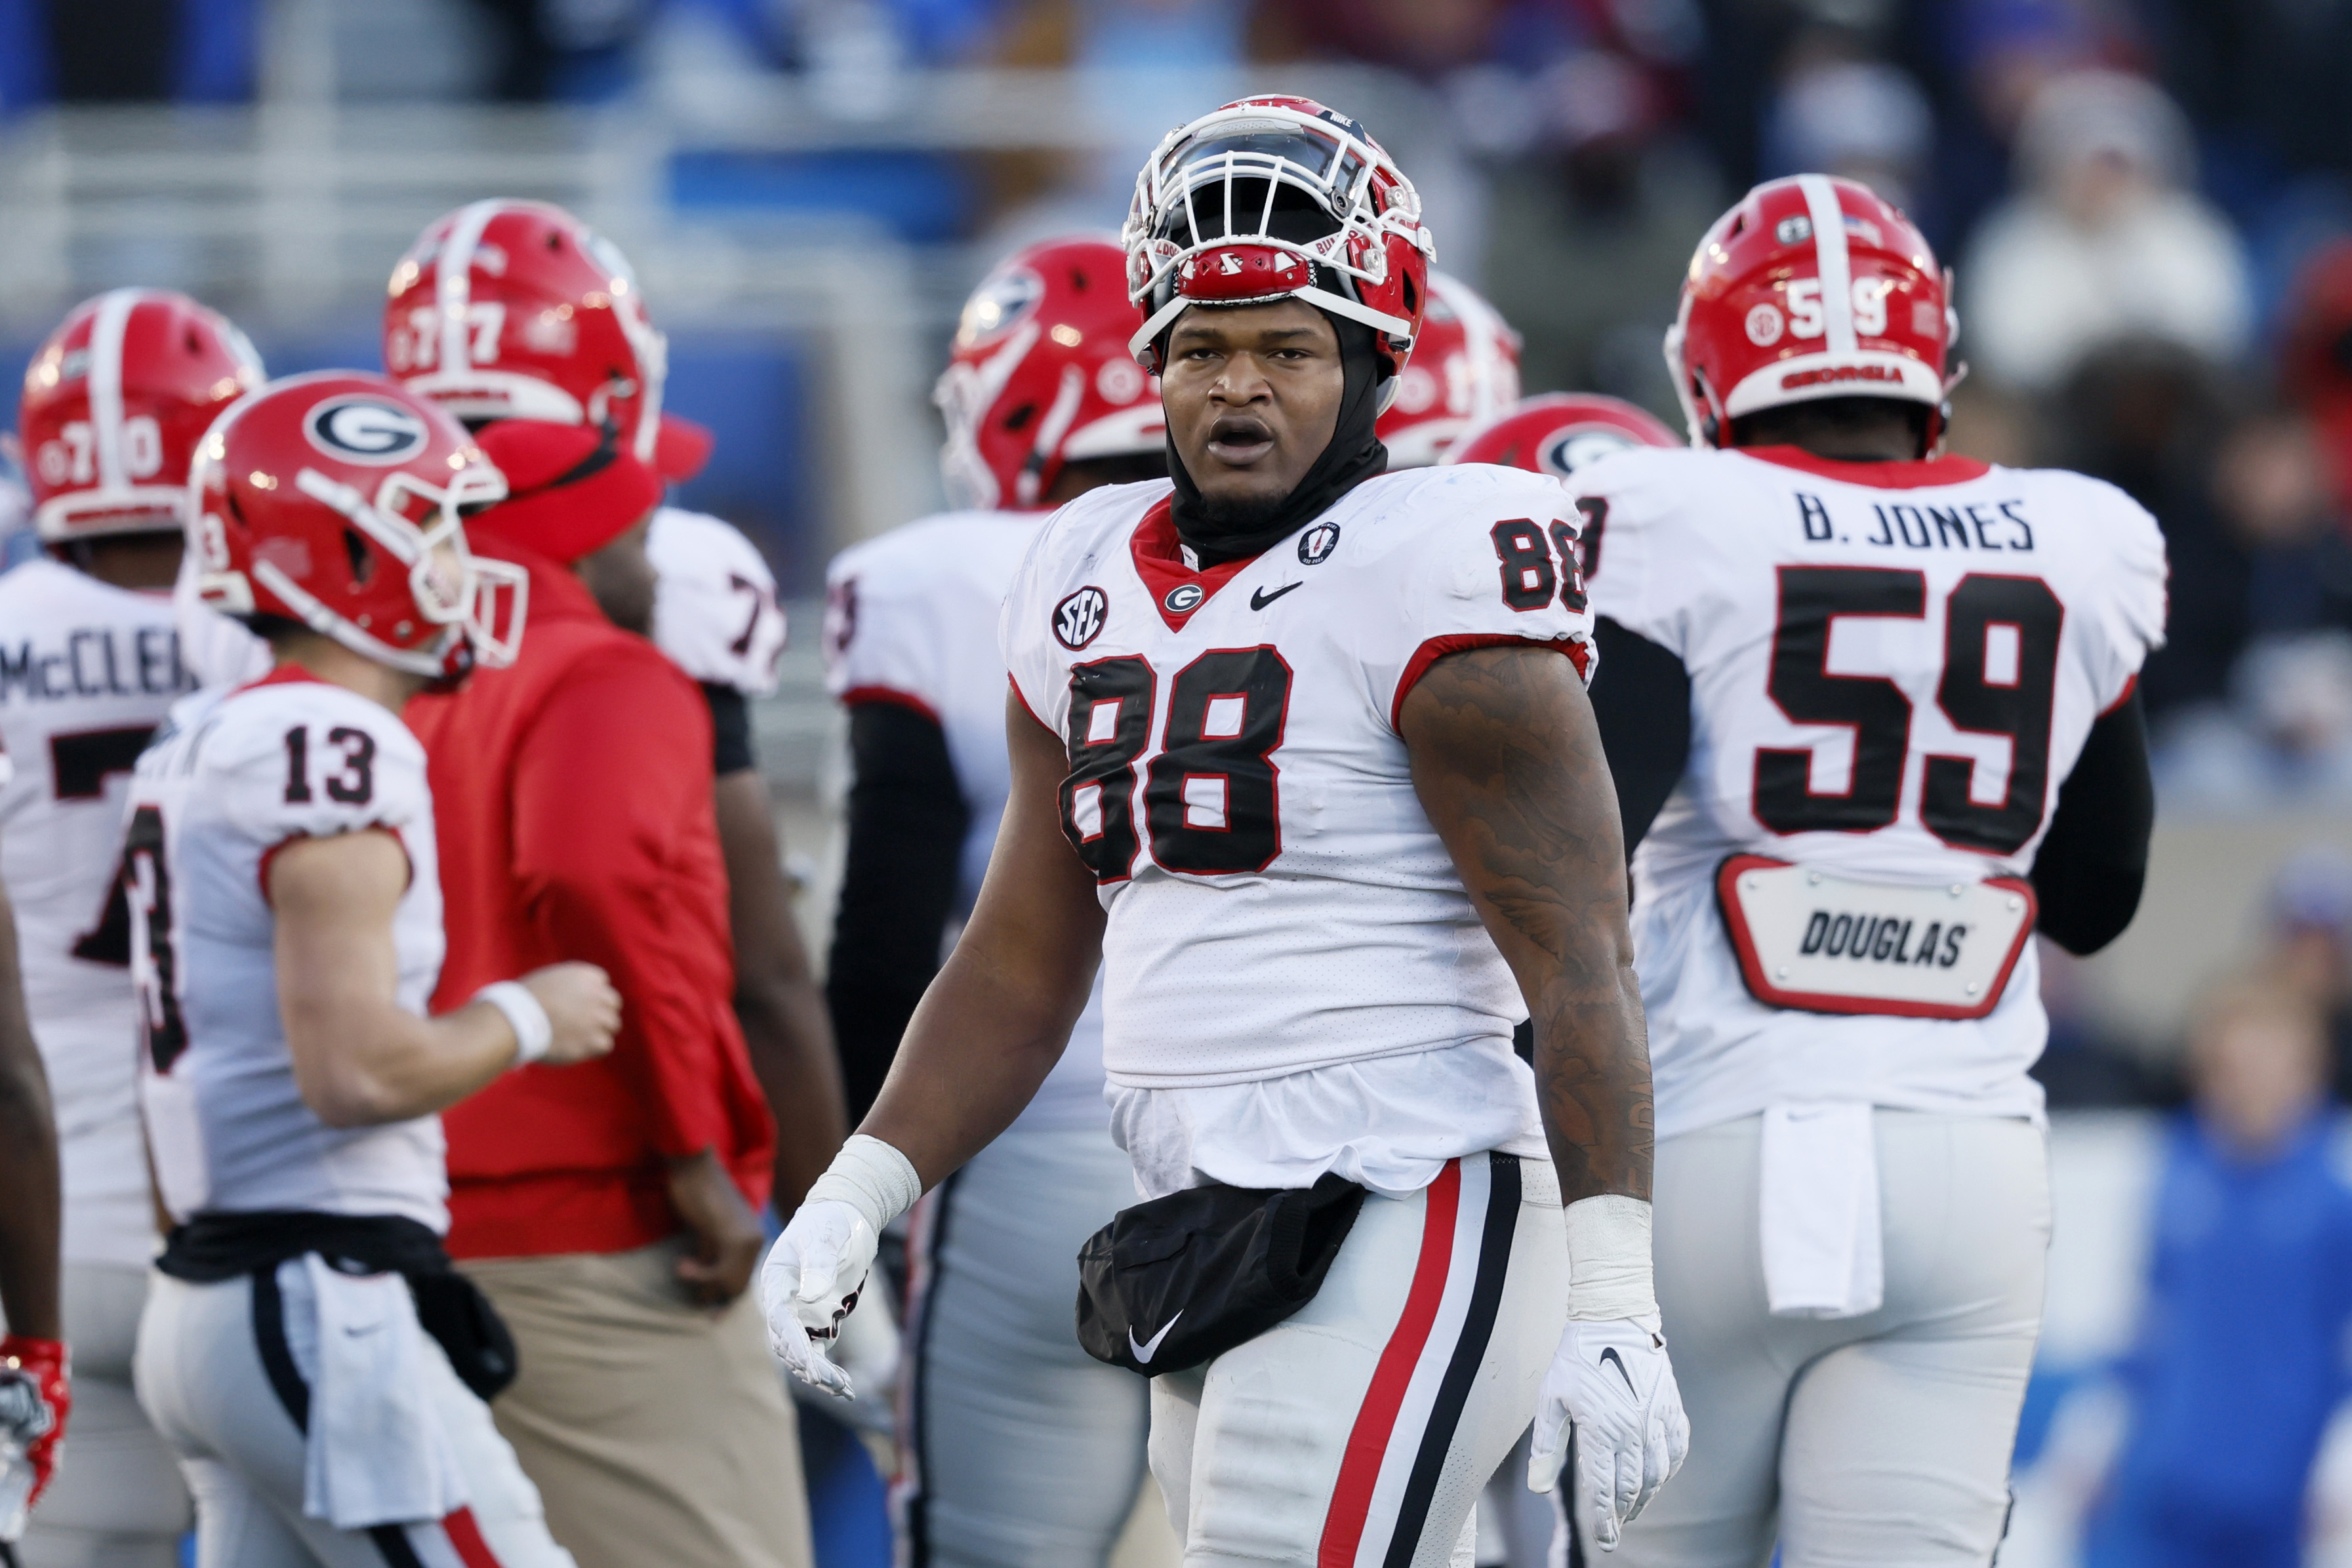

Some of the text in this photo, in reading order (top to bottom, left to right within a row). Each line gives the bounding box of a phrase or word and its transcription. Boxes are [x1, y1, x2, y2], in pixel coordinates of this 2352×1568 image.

[1329, 112, 1353, 128] NIKE
[1787, 276, 1888, 339] 59
[1794, 493, 2034, 550] B. JONES
[1490, 517, 1588, 615] 88
[1057, 589, 1105, 646] SEC
[1166, 584, 1204, 613] G
[1751, 564, 2065, 856] 59
[283, 725, 376, 805] 13
[1057, 643, 1294, 885] 88
[1800, 910, 1967, 969] DOUGLAS
